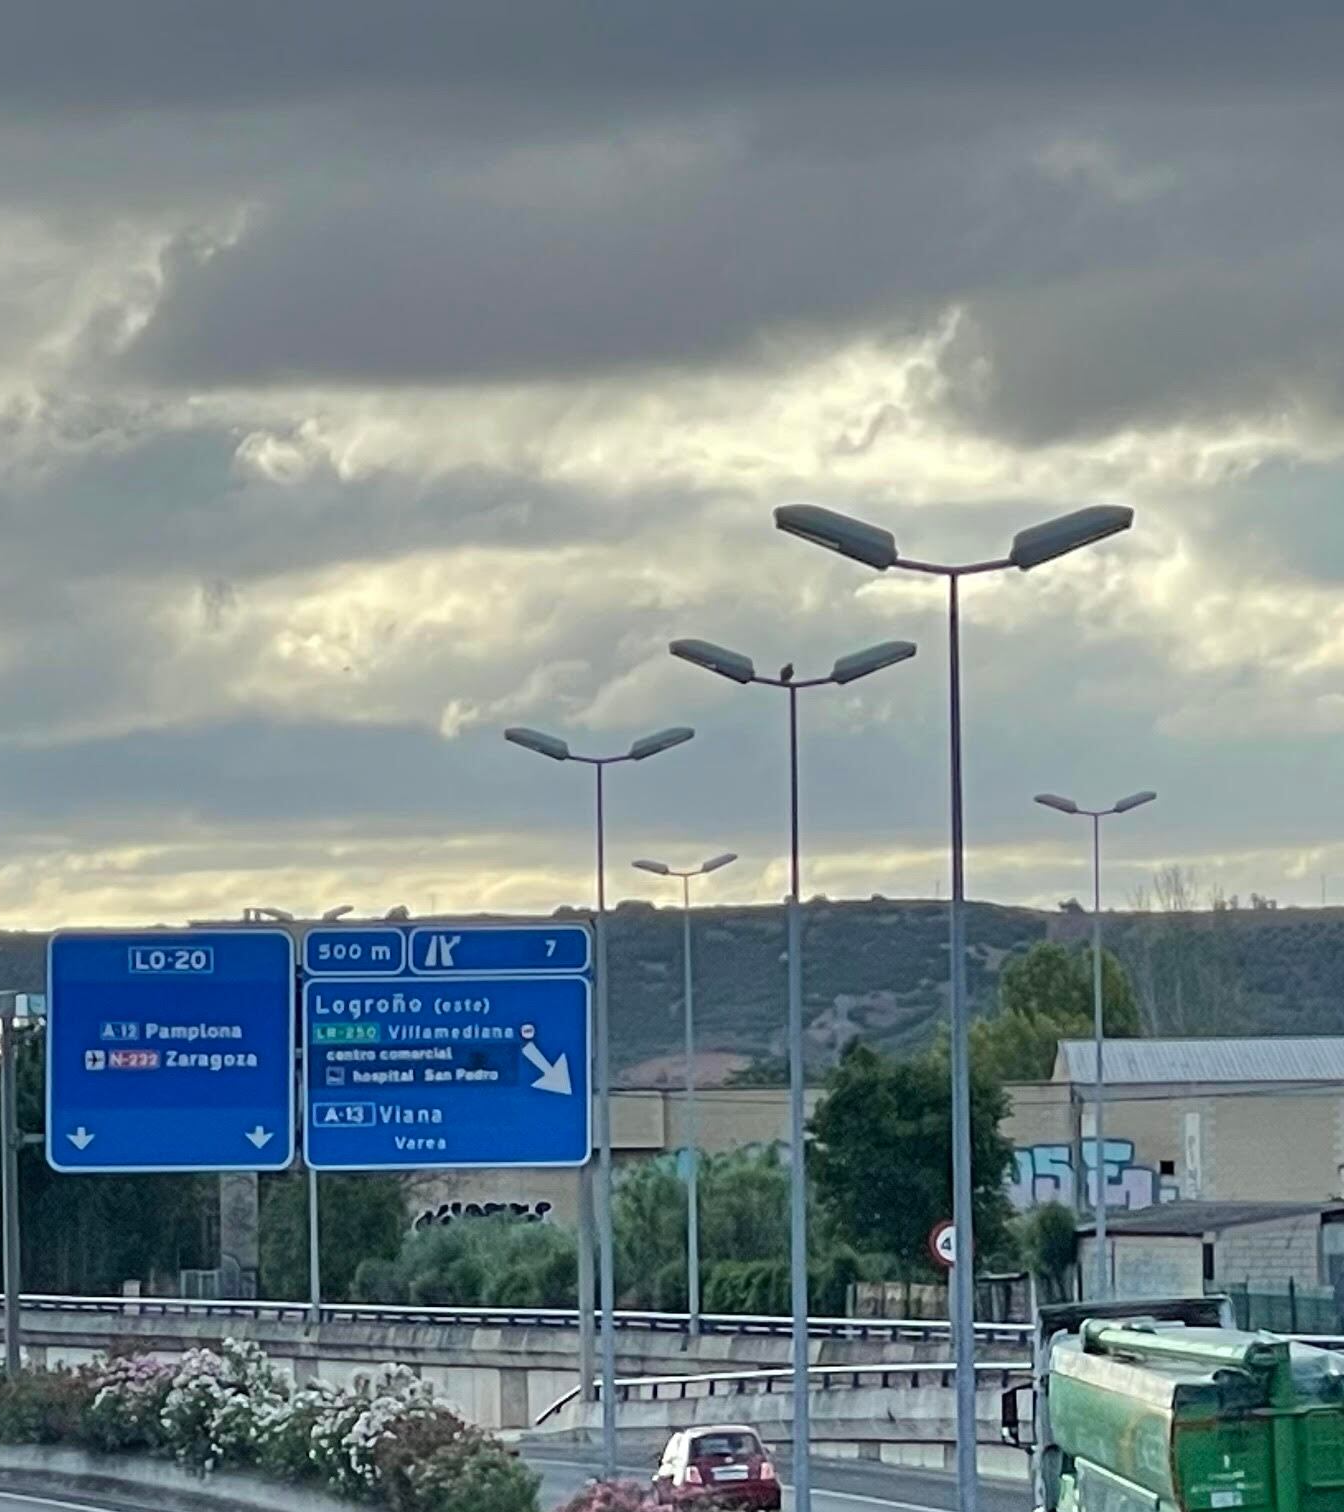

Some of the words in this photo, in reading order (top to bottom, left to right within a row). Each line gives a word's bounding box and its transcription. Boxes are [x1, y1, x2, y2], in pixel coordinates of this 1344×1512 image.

[318, 943, 362, 960] 500
[371, 944, 391, 960] m
[545, 940, 556, 957] 7
[135, 951, 207, 970] LO-20
[315, 993, 422, 1019] Logroño
[434, 997, 490, 1015] (este)
[145, 1023, 243, 1043] Pamplona
[388, 1024, 514, 1039] Villamediana
[165, 1051, 258, 1071] Zaragoza
[326, 1049, 376, 1061] centro
[379, 1047, 453, 1060] comercial
[353, 1069, 414, 1084] hospital
[424, 1068, 452, 1082] San
[457, 1067, 498, 1081] Pedro
[324, 1107, 363, 1123] A-13
[379, 1105, 442, 1123] Viana
[395, 1136, 446, 1150] Varea
